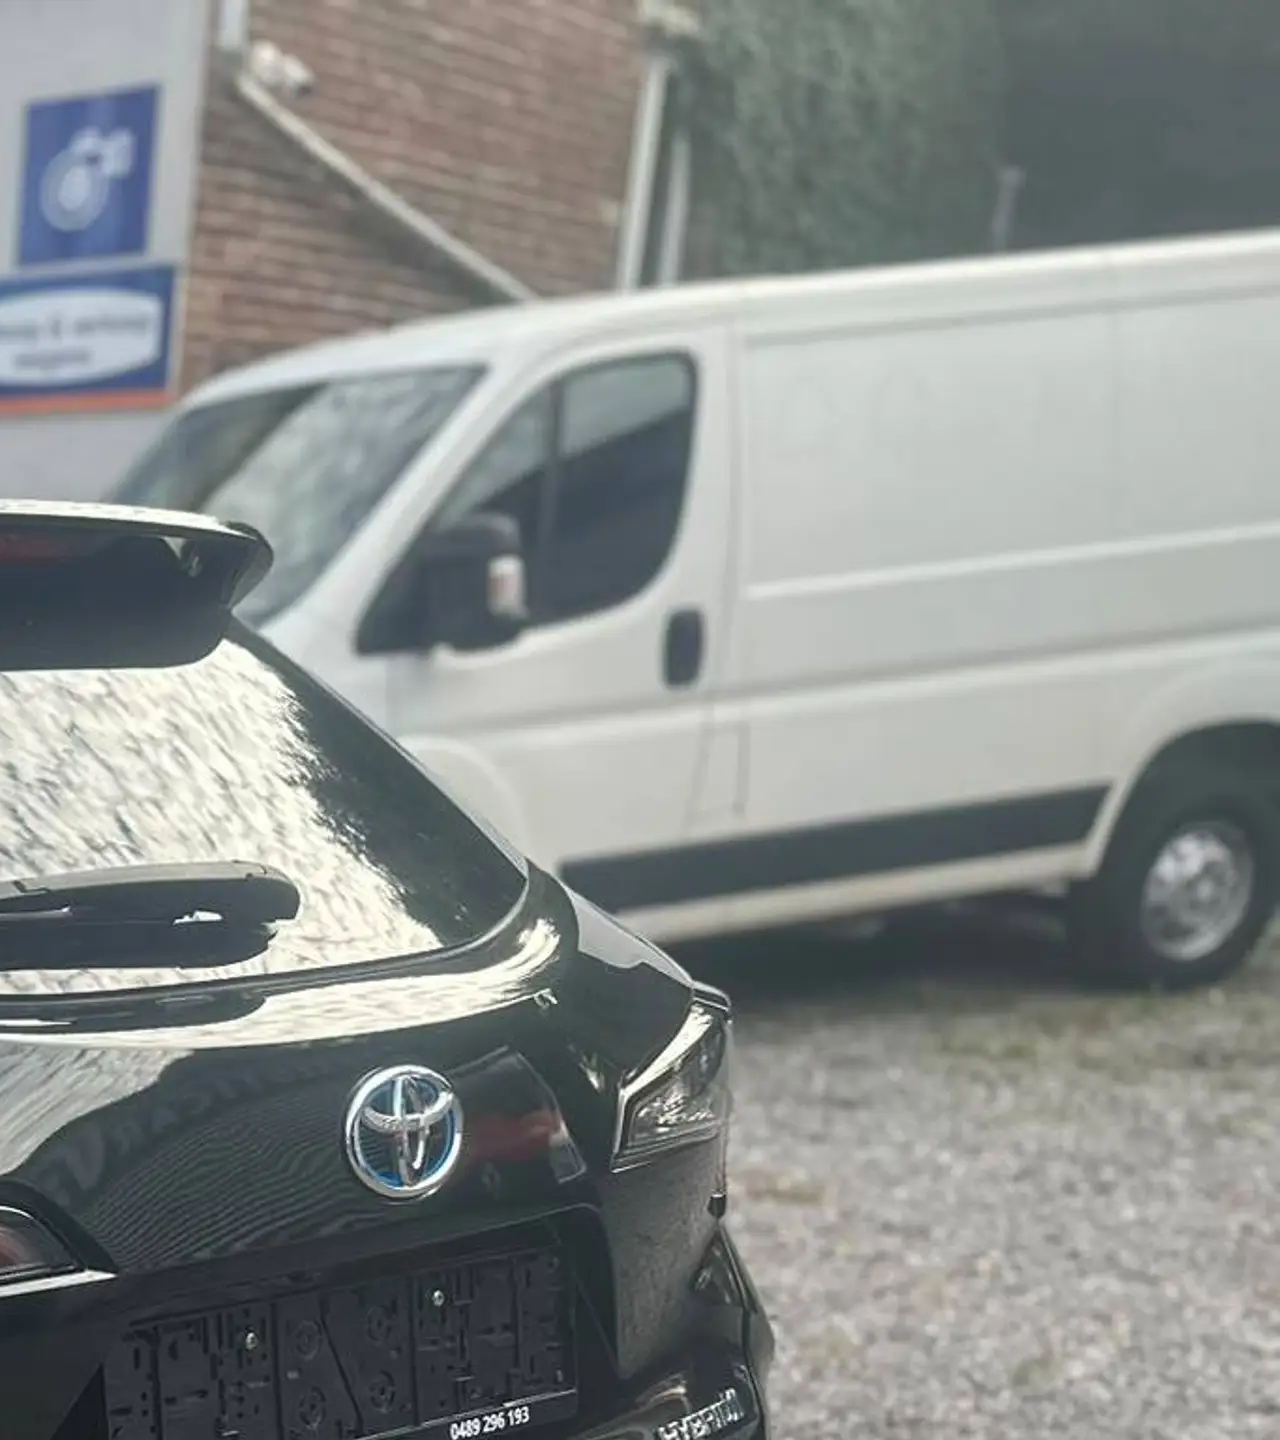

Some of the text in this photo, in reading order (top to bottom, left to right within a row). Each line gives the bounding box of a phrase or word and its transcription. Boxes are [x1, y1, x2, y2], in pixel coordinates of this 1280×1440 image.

[450, 1406, 530, 1440] 0489 296 193
